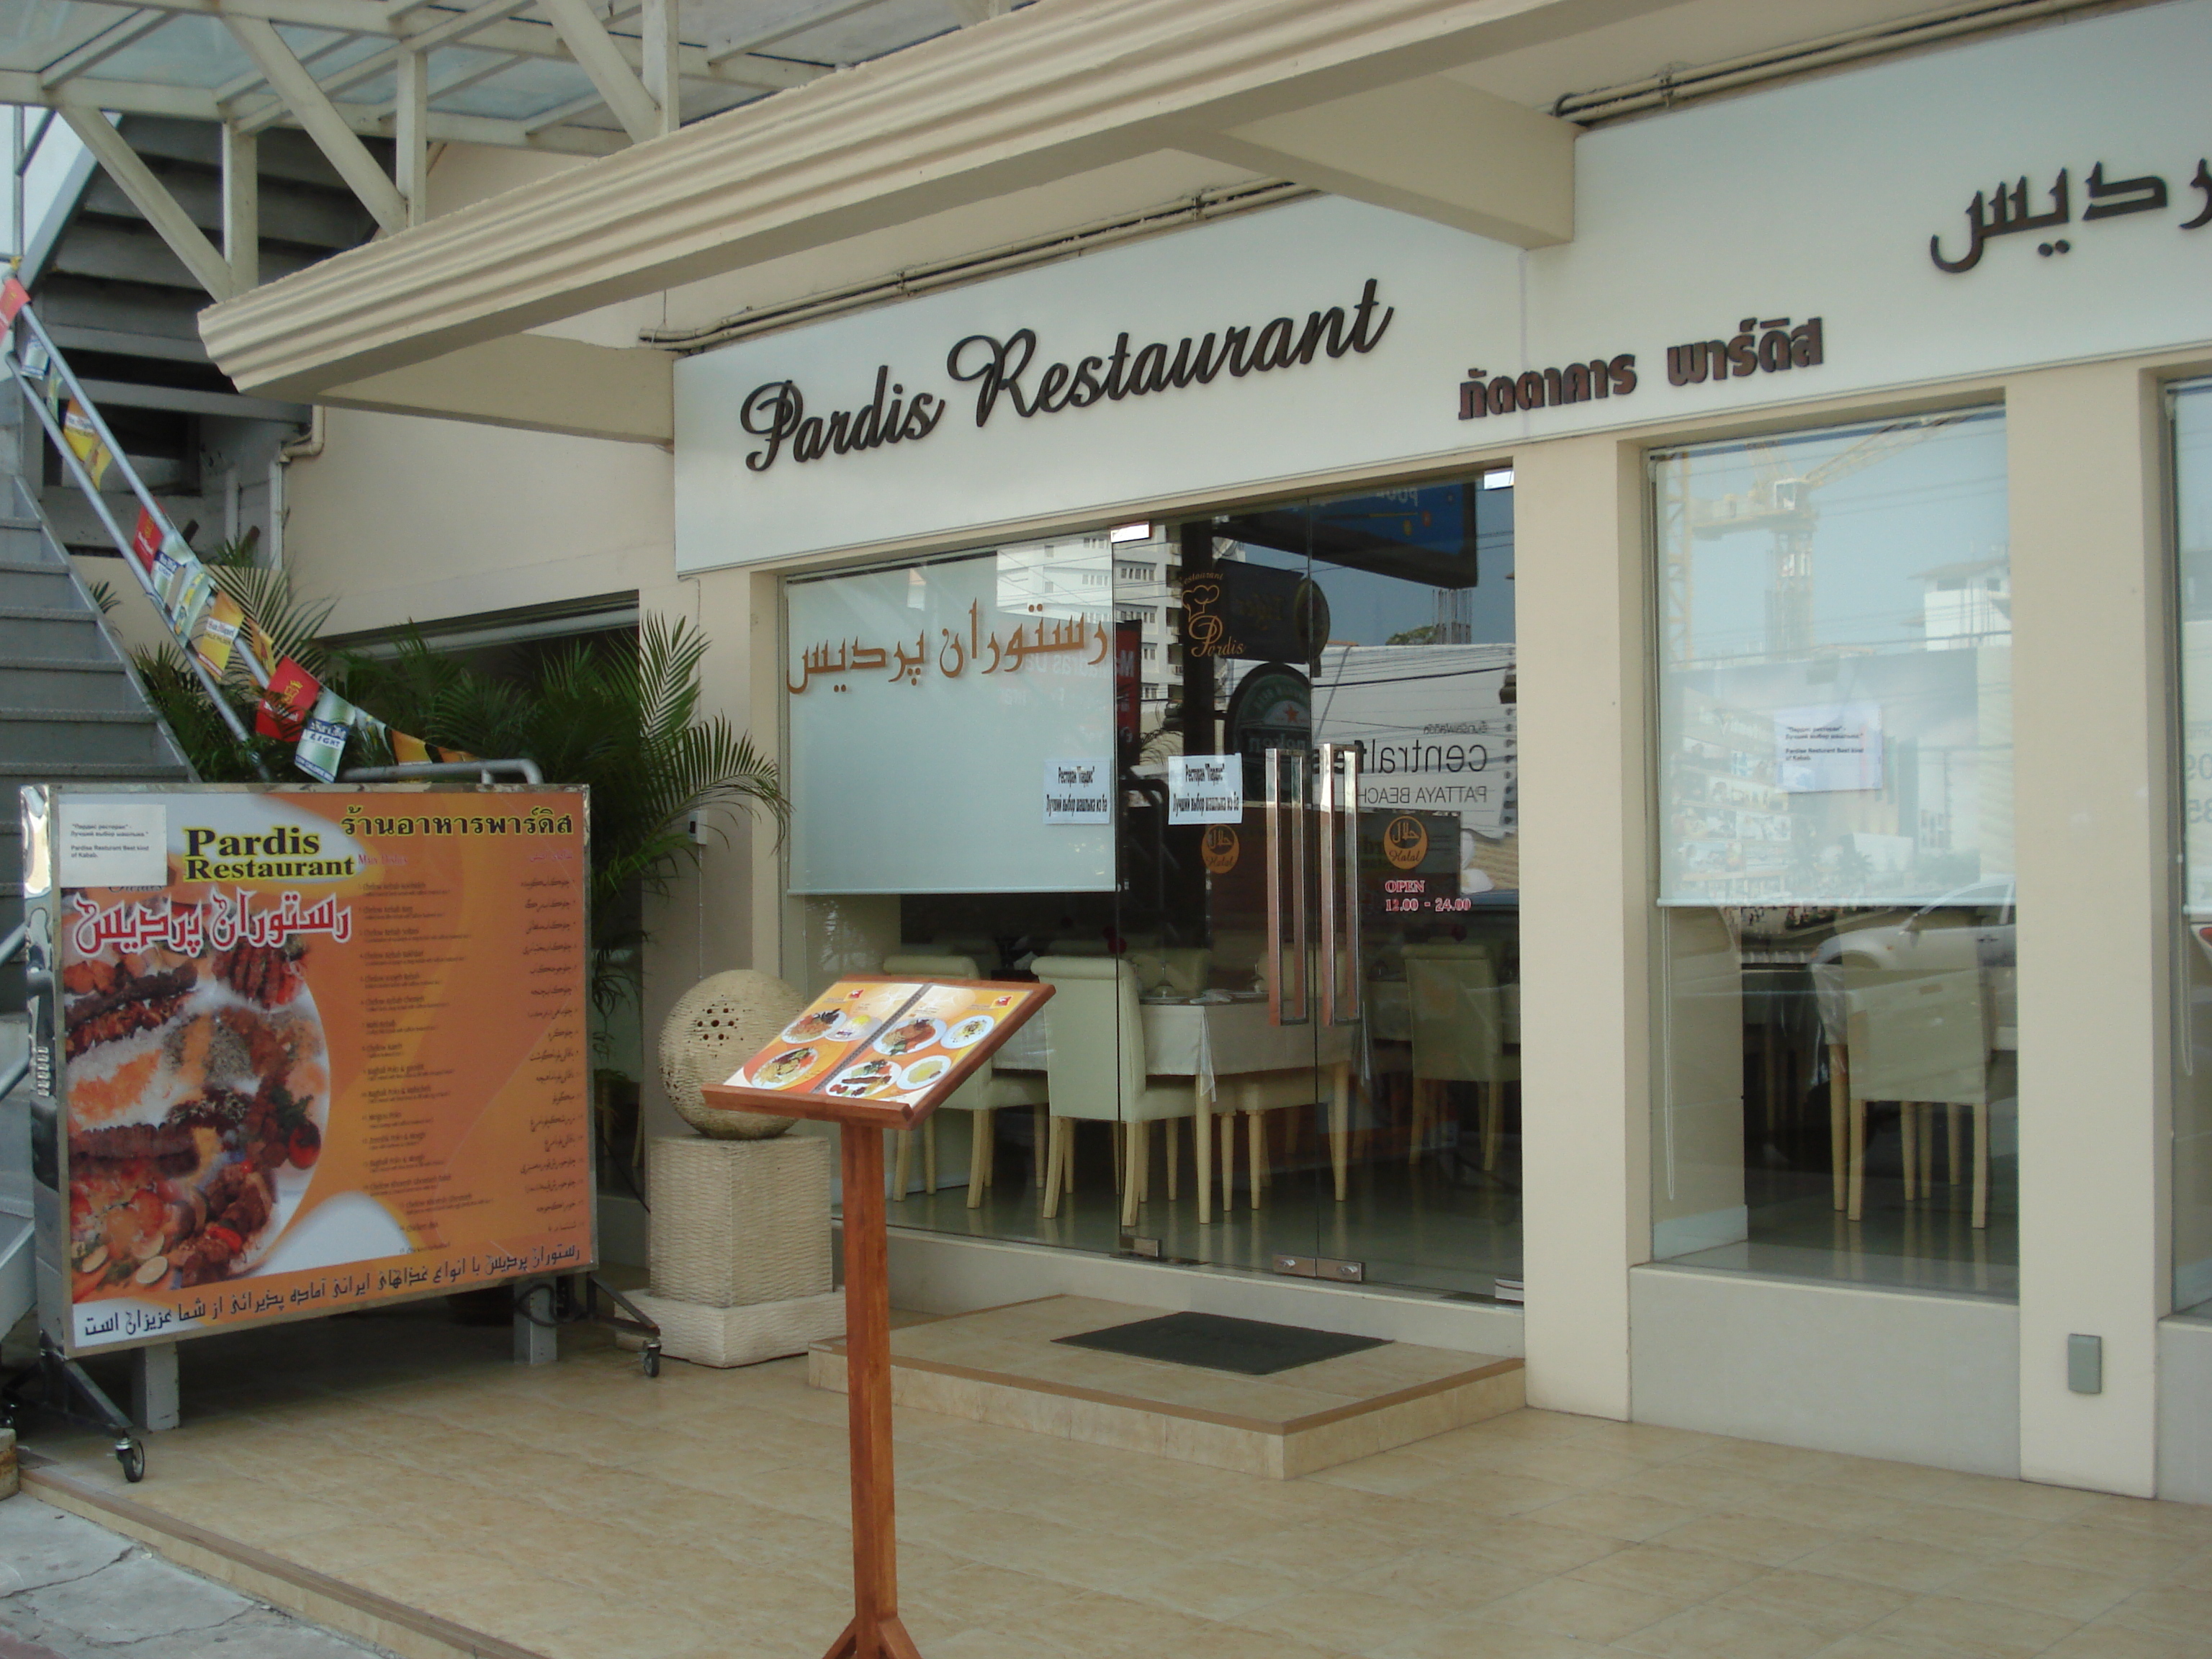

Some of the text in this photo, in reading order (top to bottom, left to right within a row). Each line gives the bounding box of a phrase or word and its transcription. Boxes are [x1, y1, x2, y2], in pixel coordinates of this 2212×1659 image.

[1930, 158, 2212, 274] ردیس
[740, 278, 1395, 472] Pardis Restaurant
[1458, 354, 1637, 421] ภัตตาคาร
[786, 597, 1109, 694] رستوران پردیس
[310, 733, 341, 747] LIGHT
[340, 805, 572, 835] ร้านอาหารพาร์ดิส
[186, 826, 321, 858] Pardis
[1392, 822, 1420, 844] حلال
[1389, 850, 1421, 862] Halal
[184, 857, 355, 881] Restaurant
[1385, 880, 1425, 893] OPEN
[1385, 898, 1419, 912] 12.00
[1434, 897, 1472, 912] 24.00
[73, 884, 351, 958] رستوران پردیس
[472, 1259, 481, 1274] با
[485, 1254, 528, 1277] پردیس
[531, 1244, 580, 1269] رستوران
[433, 1257, 466, 1283] انواع
[178, 1297, 207, 1322] شما
[212, 1296, 223, 1320] از
[84, 1312, 119, 1336] است
